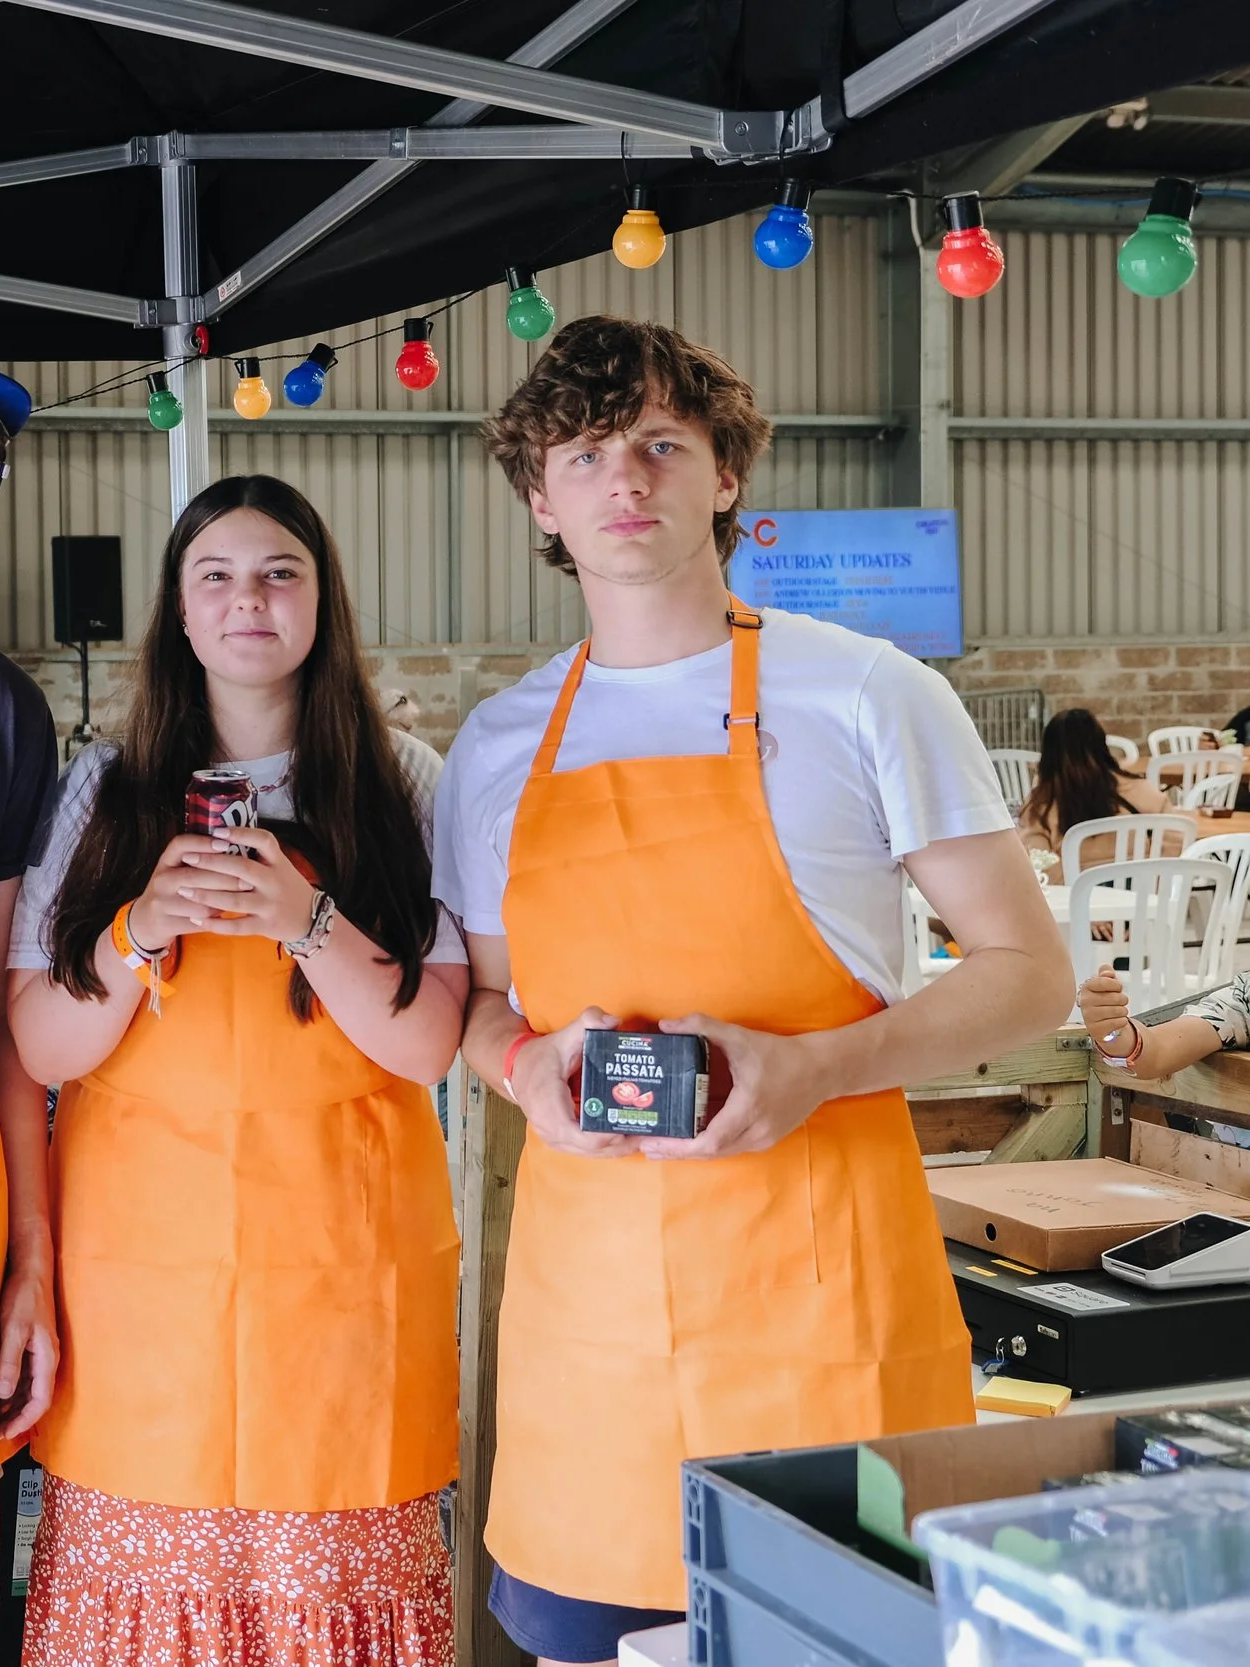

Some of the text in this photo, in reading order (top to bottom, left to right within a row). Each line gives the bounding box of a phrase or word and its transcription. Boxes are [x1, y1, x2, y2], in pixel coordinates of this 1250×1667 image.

[752, 553, 912, 570] SATURDAY UPDATES
[614, 1053, 656, 1065] TOMATO
[605, 1062, 664, 1079] PASSATA
[22, 1481, 38, 1490] Clip
